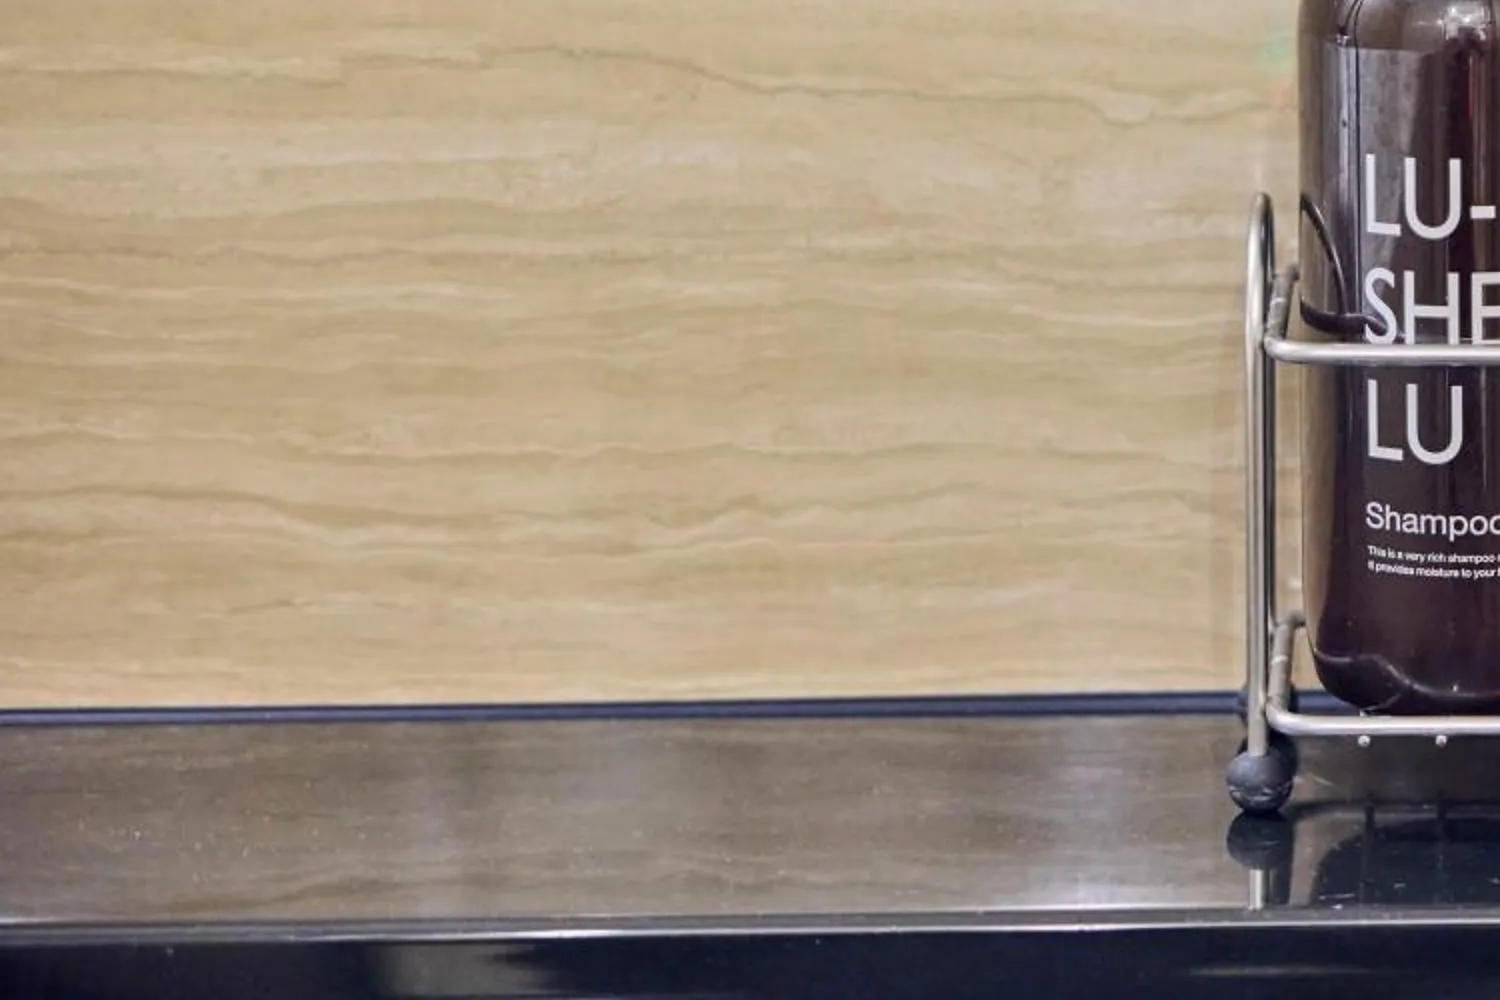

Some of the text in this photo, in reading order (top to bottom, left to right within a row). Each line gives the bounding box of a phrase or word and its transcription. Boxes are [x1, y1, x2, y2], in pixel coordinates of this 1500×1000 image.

[1365, 153, 1496, 239] LU-
[1367, 379, 1463, 465] LU
[1367, 545, 1387, 557] This
[1387, 546, 1397, 559] is
[1404, 552, 1425, 563] very
[1427, 552, 1446, 561] rich
[1448, 553, 1495, 565] shampoo
[1461, 568, 1472, 578] to
[1473, 569, 1496, 580] your
